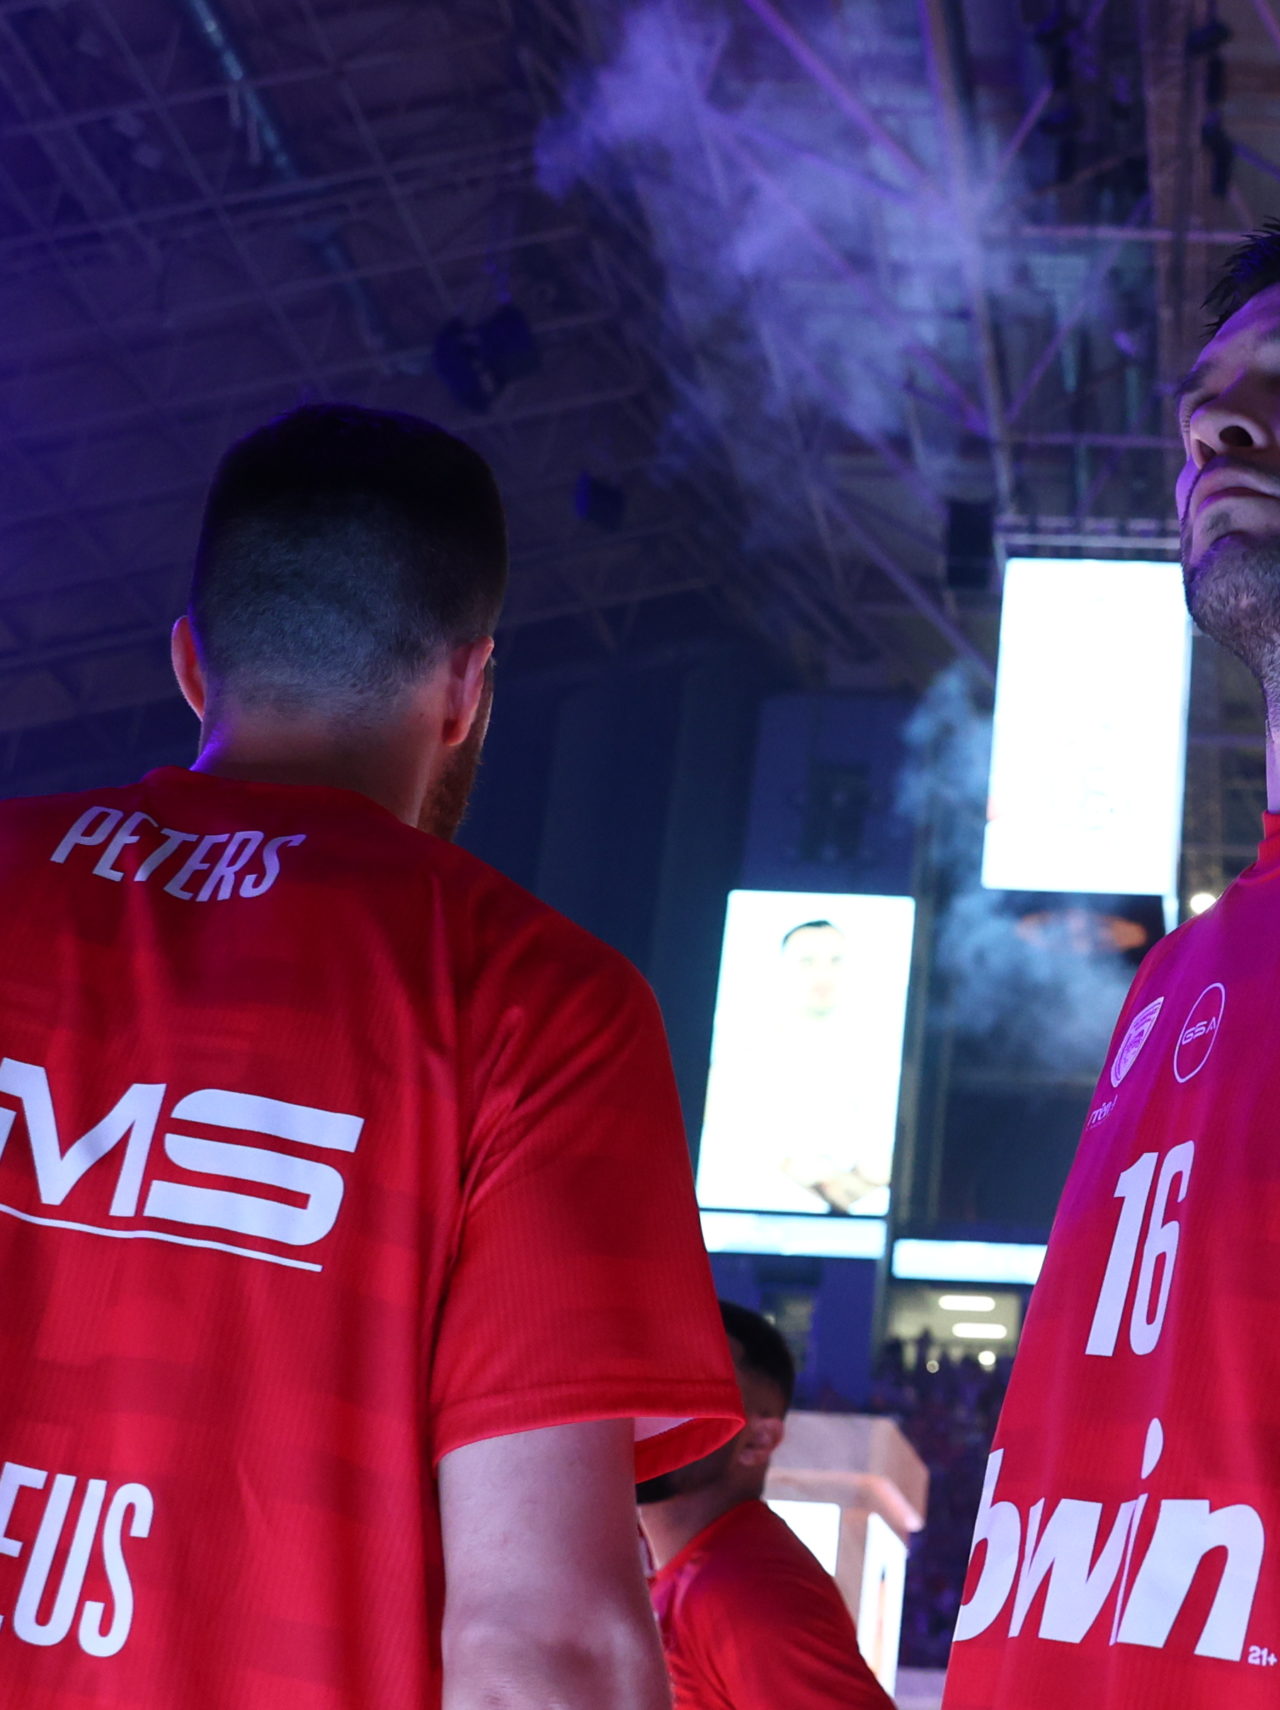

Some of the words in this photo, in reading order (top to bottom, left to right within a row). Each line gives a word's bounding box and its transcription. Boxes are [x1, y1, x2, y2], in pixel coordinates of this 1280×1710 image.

[51, 805, 308, 902] PETERS
[1181, 1016, 1217, 1046] GSA
[1085, 1140, 1195, 1357] 16
[952, 1417, 1265, 1662] bwin
[1248, 1645, 1278, 1667] 21+
